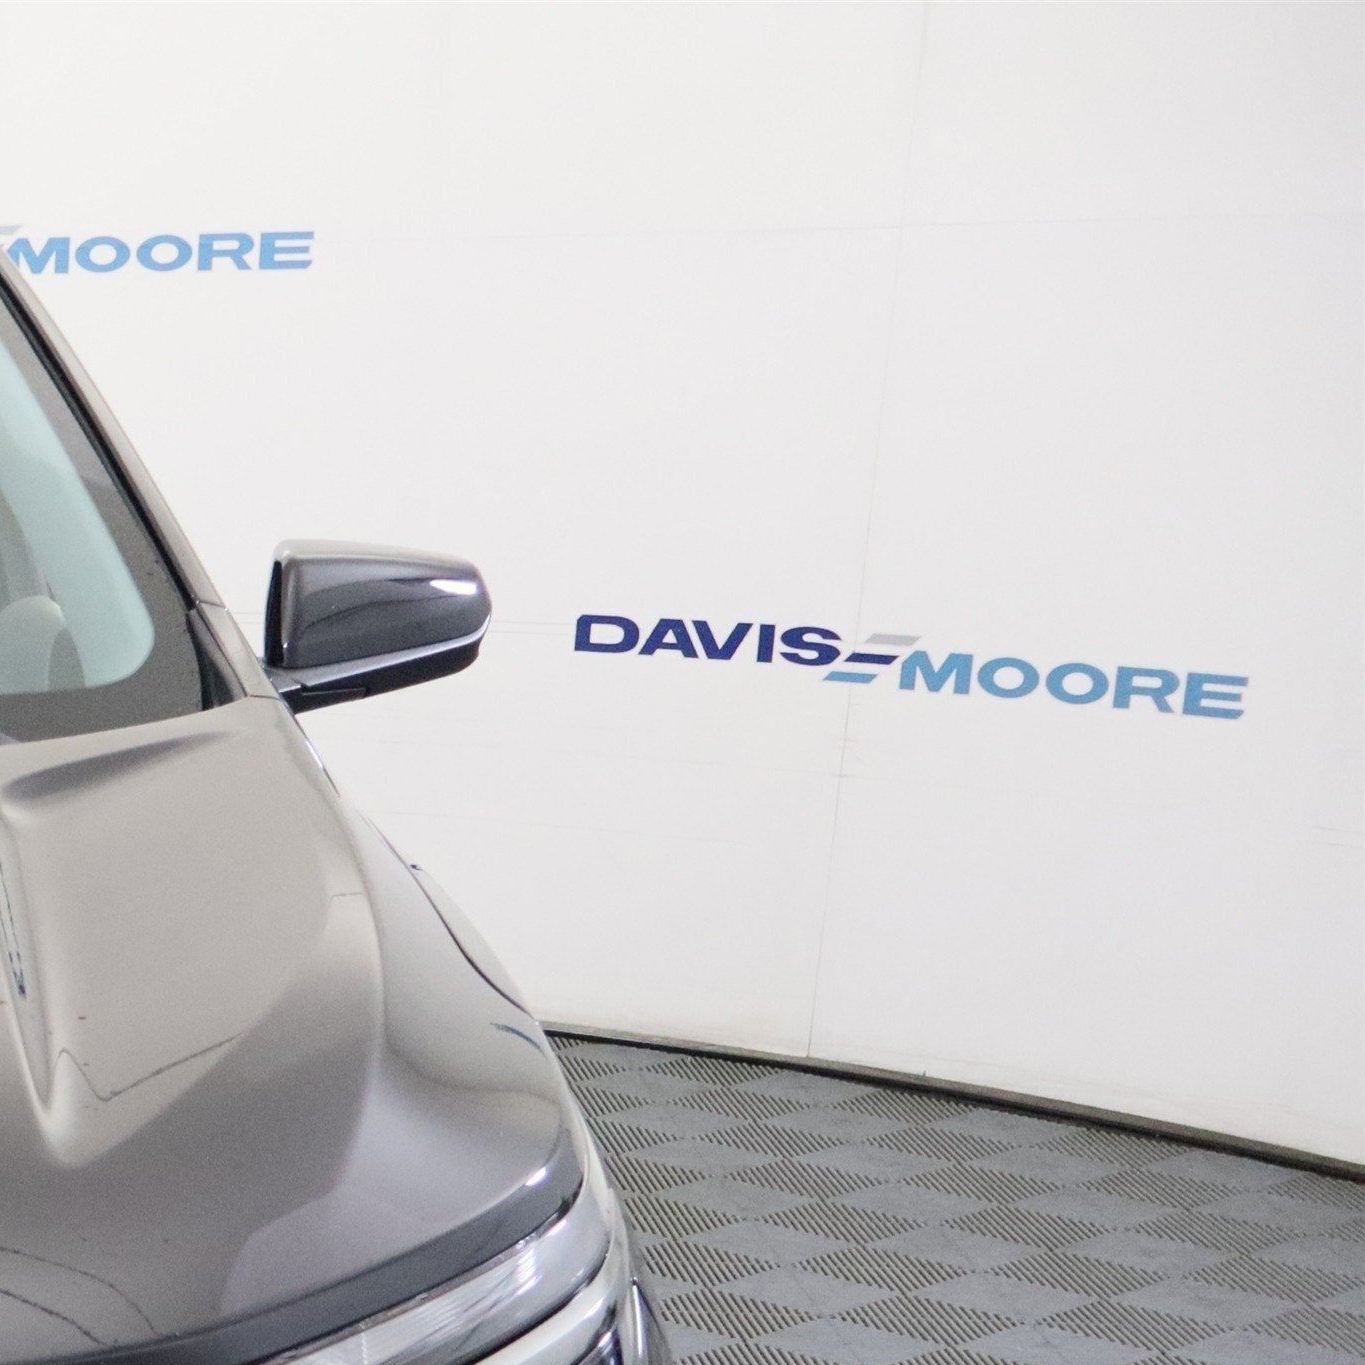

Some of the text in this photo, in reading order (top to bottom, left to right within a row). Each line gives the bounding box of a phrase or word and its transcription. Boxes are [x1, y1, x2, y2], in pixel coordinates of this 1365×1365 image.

[6, 231, 315, 275] MOORE
[573, 613, 1250, 722] DAVIS MOORE
